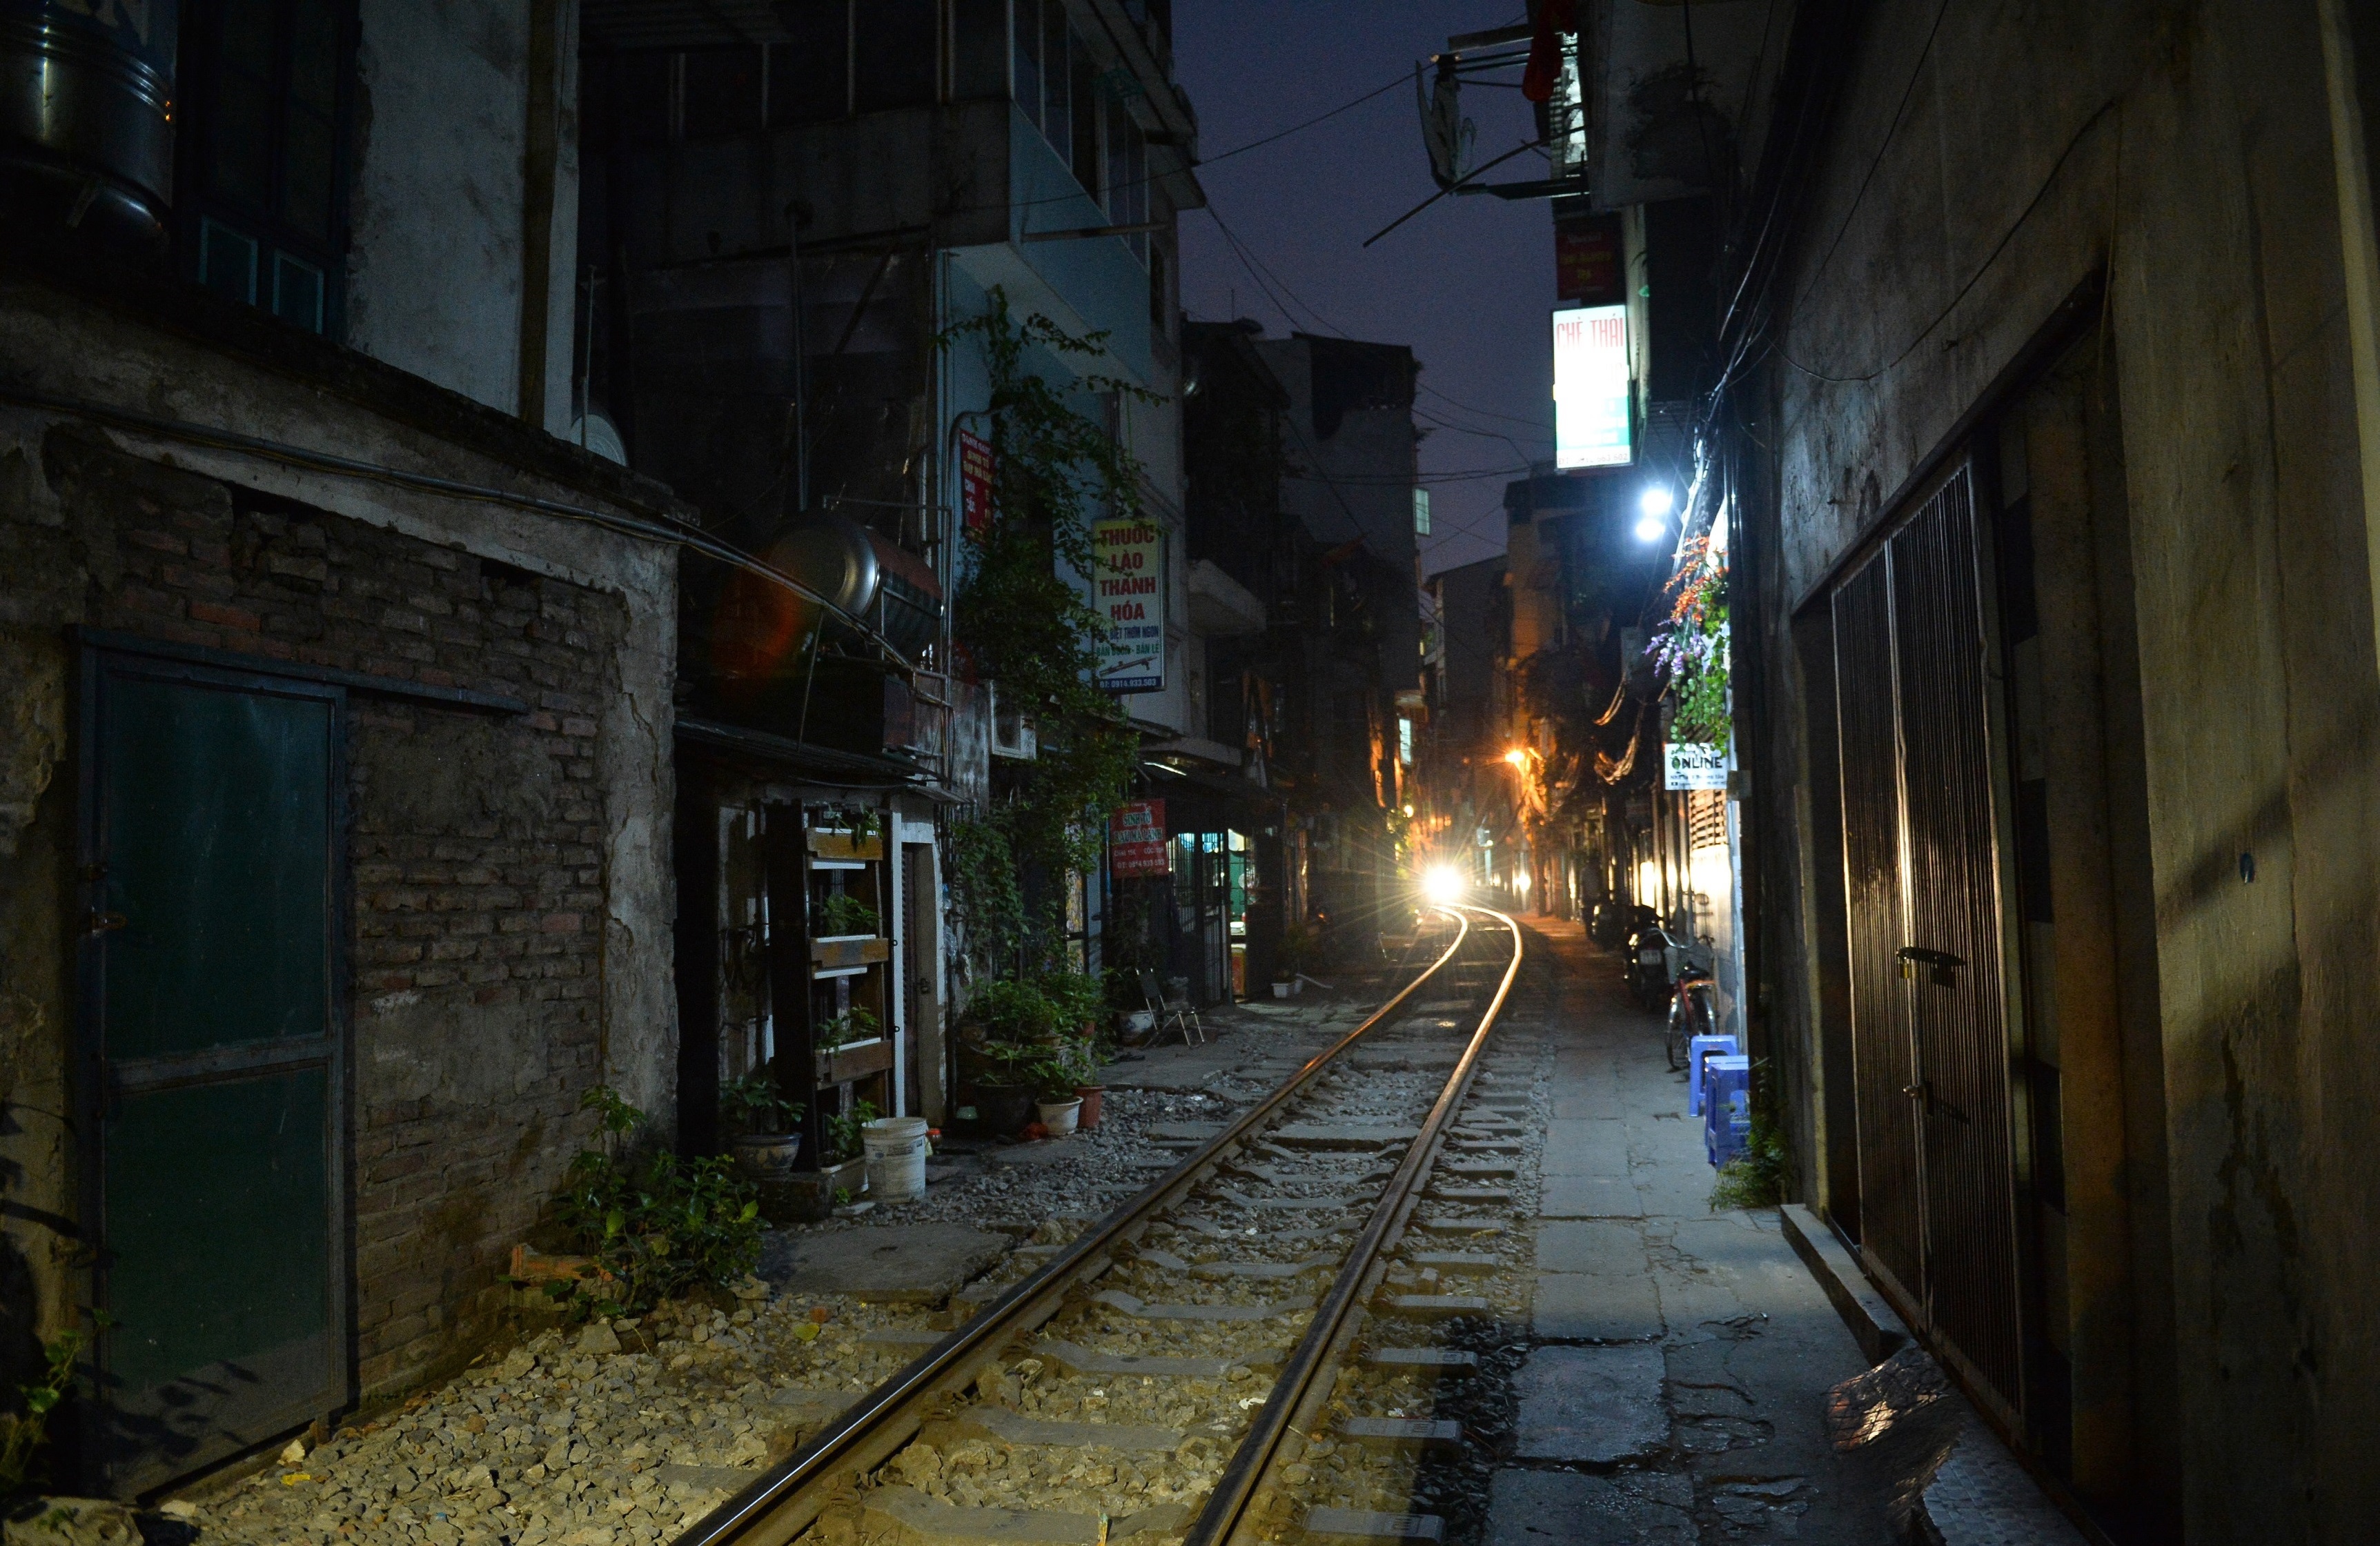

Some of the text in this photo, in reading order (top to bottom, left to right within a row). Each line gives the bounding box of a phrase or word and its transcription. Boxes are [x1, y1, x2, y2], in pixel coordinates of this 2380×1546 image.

[1556, 313, 1624, 349] CHÈ THÁI
[1110, 550, 1143, 569] LÀO
[1100, 577, 1156, 596] THANH
[1110, 600, 1145, 620] HÓA
[1671, 757, 1722, 769] ONLINE
